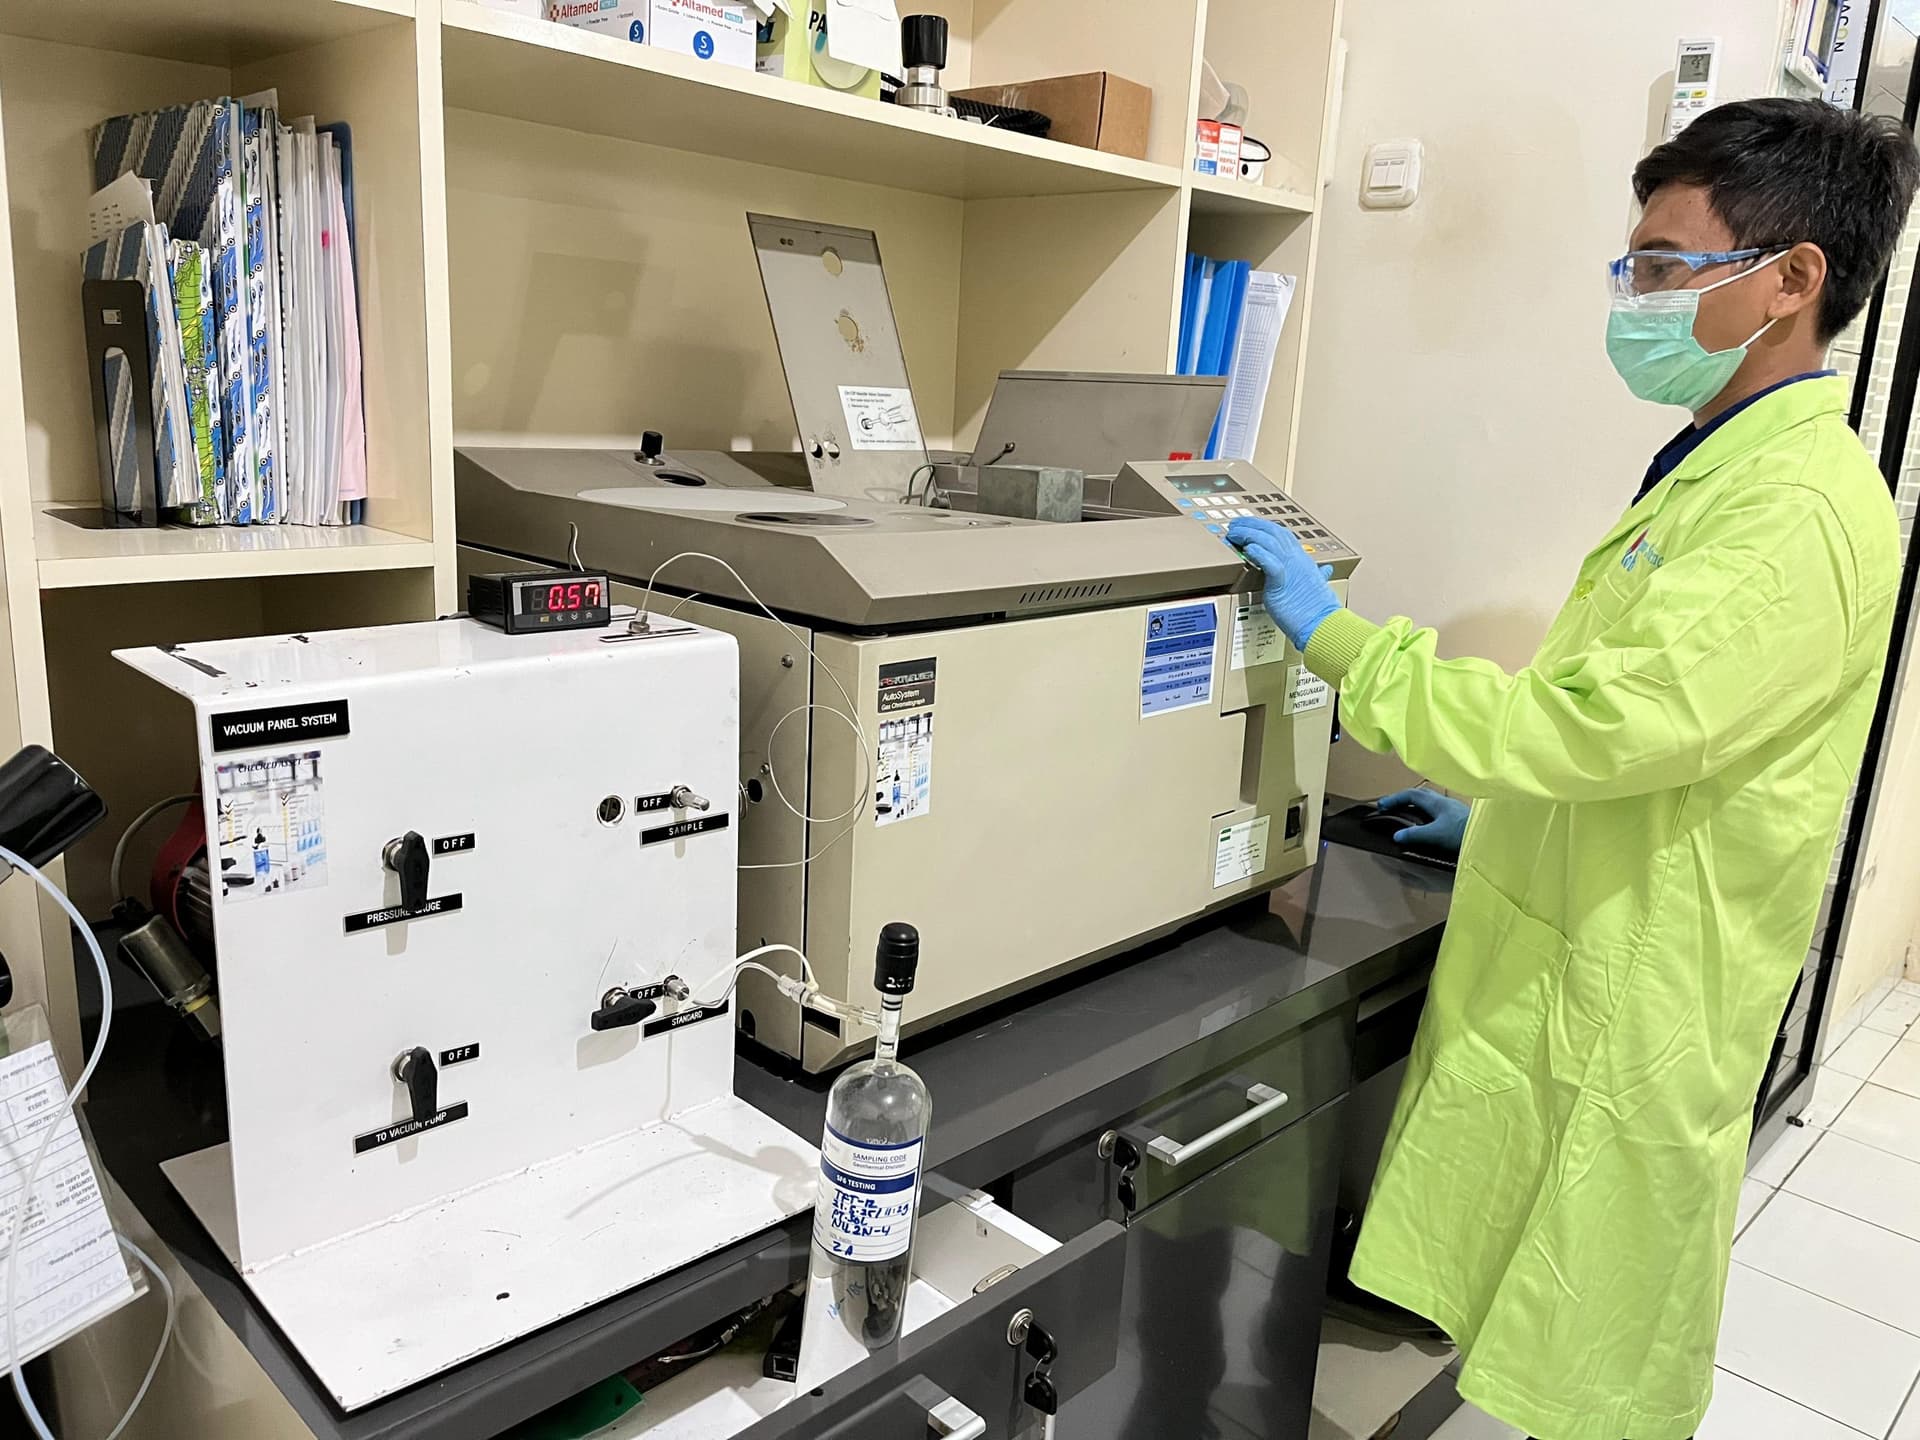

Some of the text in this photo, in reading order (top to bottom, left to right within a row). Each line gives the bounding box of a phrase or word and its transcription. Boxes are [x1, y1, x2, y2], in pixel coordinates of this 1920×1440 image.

[561, 0, 599, 18] Altamed
[682, 0, 724, 18] Altamed
[808, 10, 827, 34] PA
[633, 24, 639, 38] S
[700, 35, 708, 49] S
[548, 583, 600, 610] 0.57
[882, 689, 920, 702] AutoSystem
[224, 713, 337, 736] VACUUM PANEL SYSTEM
[642, 797, 662, 808] OFF
[668, 821, 704, 836] SAMPLE
[442, 837, 467, 850] OFF
[637, 987, 657, 999] OFF
[671, 1010, 703, 1026] STANDARD
[448, 1047, 471, 1061] OFF
[375, 1134, 387, 1143] TO
[389, 1120, 422, 1138] VACUUM
[853, 1152, 906, 1162] SAMPLING CODE
[848, 1179, 876, 1191] TESTING
